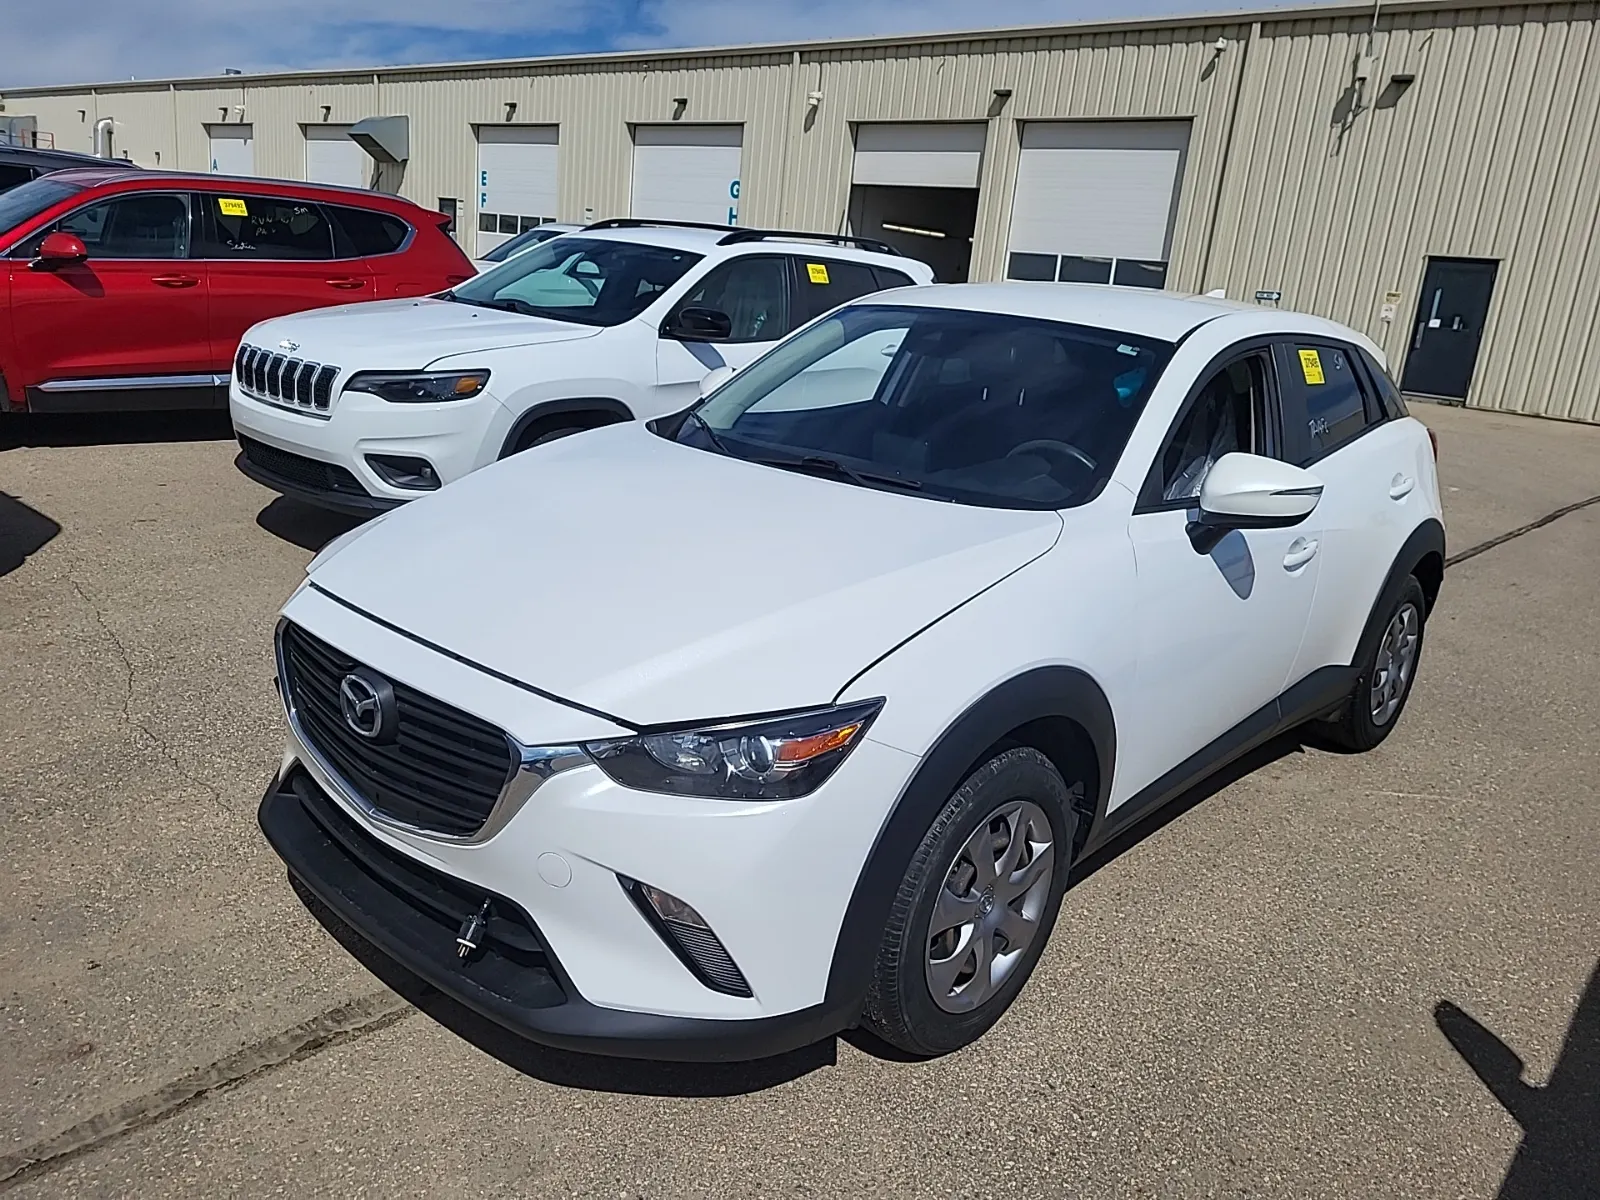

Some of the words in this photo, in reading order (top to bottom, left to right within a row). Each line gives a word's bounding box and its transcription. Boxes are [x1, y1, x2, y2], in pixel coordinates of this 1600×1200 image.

[212, 158, 218, 171] A
[481, 170, 488, 186] E
[730, 180, 741, 199] G
[481, 192, 487, 208] F
